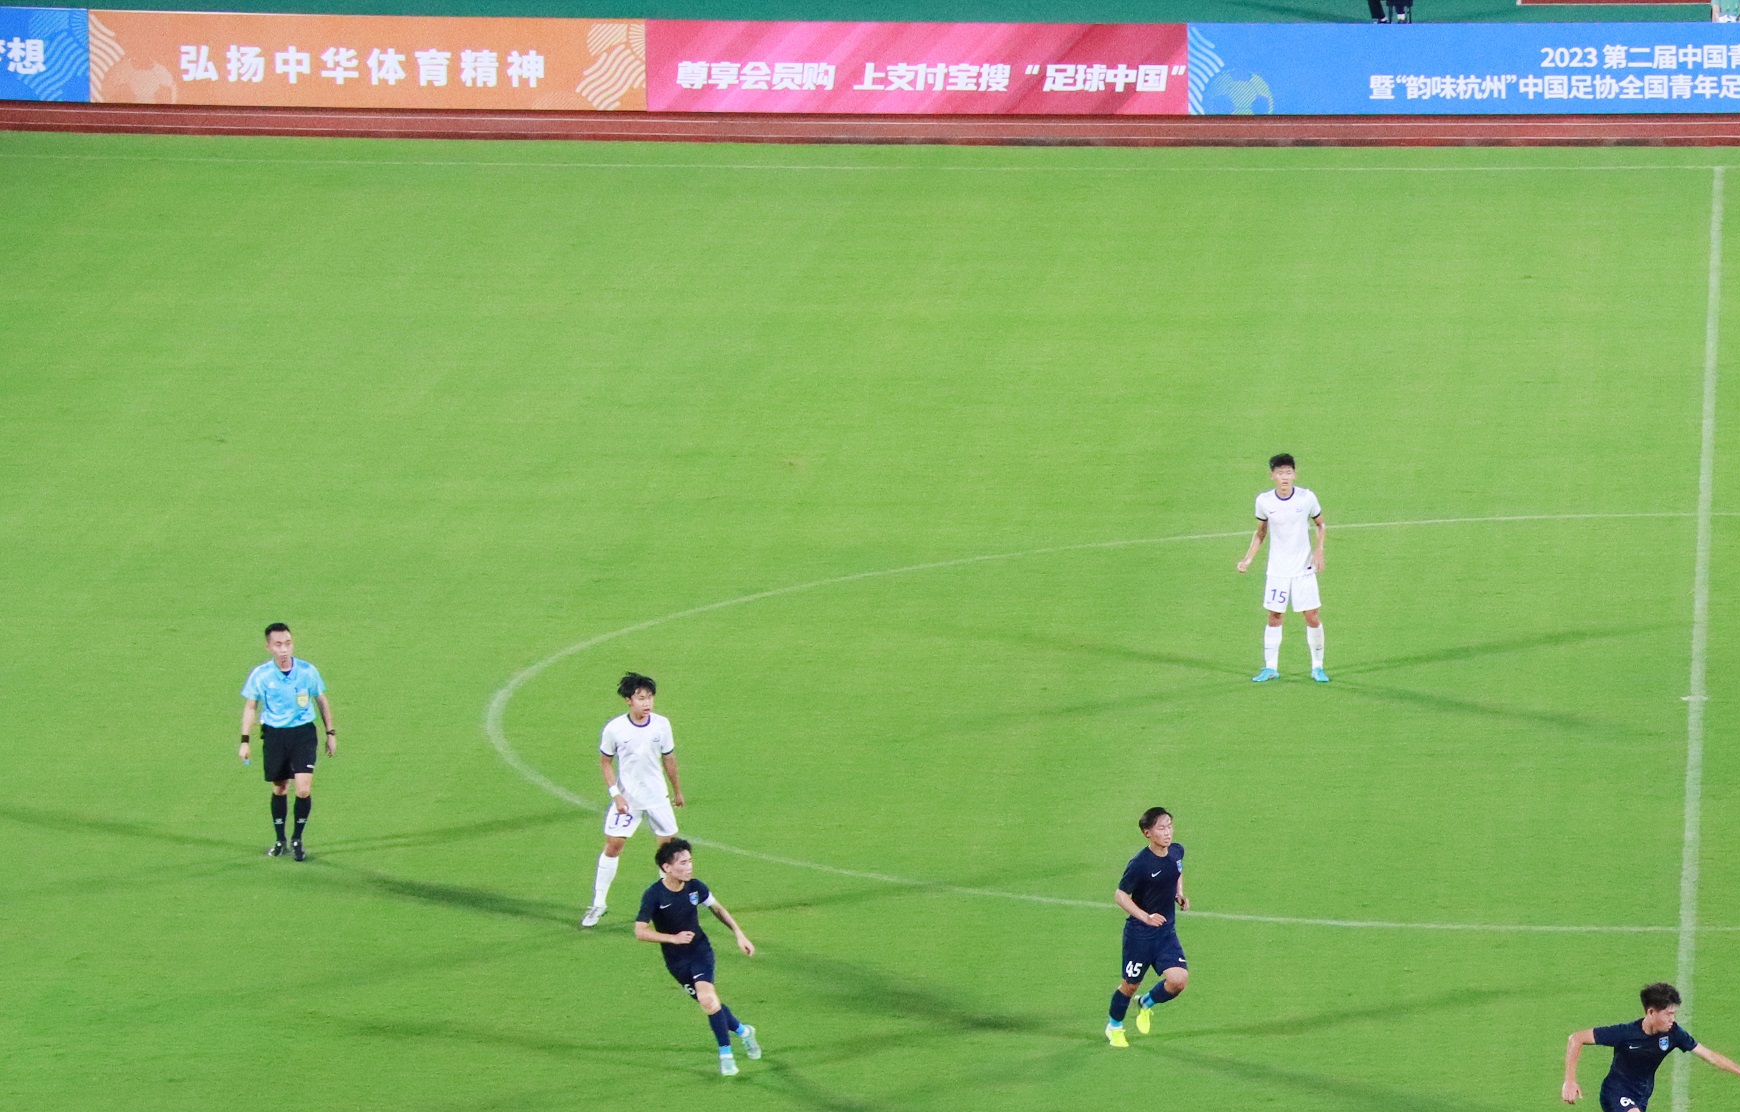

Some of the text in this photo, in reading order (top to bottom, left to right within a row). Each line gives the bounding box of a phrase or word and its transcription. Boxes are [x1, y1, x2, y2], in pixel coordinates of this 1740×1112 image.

[0, 37, 46, 74] 想
[179, 44, 546, 88] 弘扬中华体育精神
[1539, 47, 1598, 68] 2023
[676, 60, 836, 90] 尊享会员购
[852, 62, 1011, 92] 上支付宝搜
[1271, 589, 1287, 604] 15
[1125, 960, 1143, 978] 45
